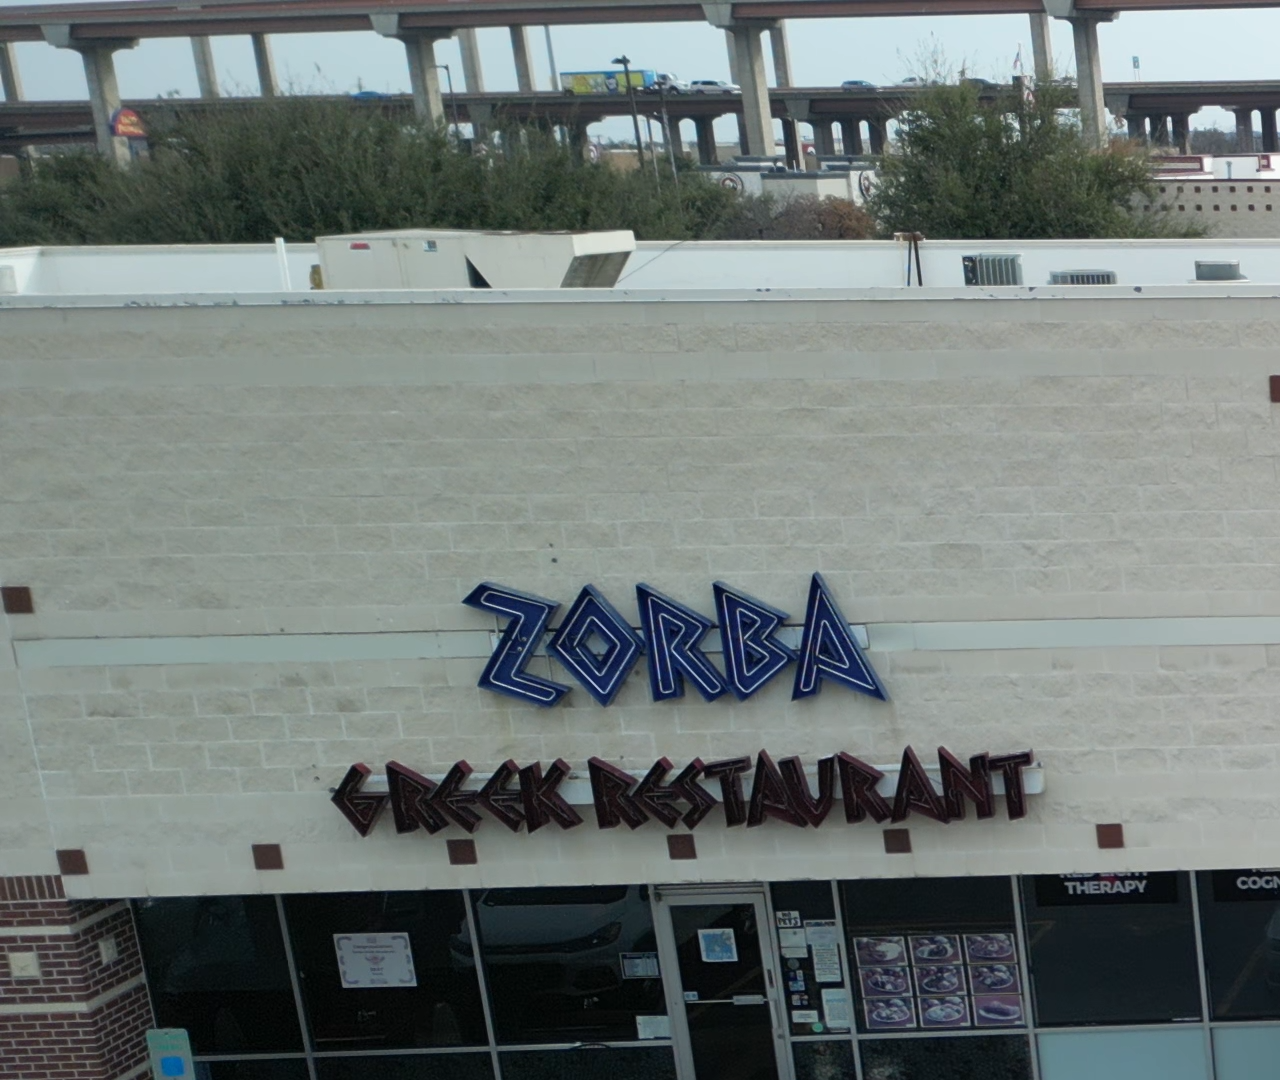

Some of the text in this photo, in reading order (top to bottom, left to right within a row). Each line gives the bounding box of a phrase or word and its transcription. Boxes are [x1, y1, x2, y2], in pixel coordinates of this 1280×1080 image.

[462, 571, 890, 707] ZORBA
[331, 745, 1034, 838] GREEK RESTAURANT
[1064, 880, 1148, 895] THERAPY
